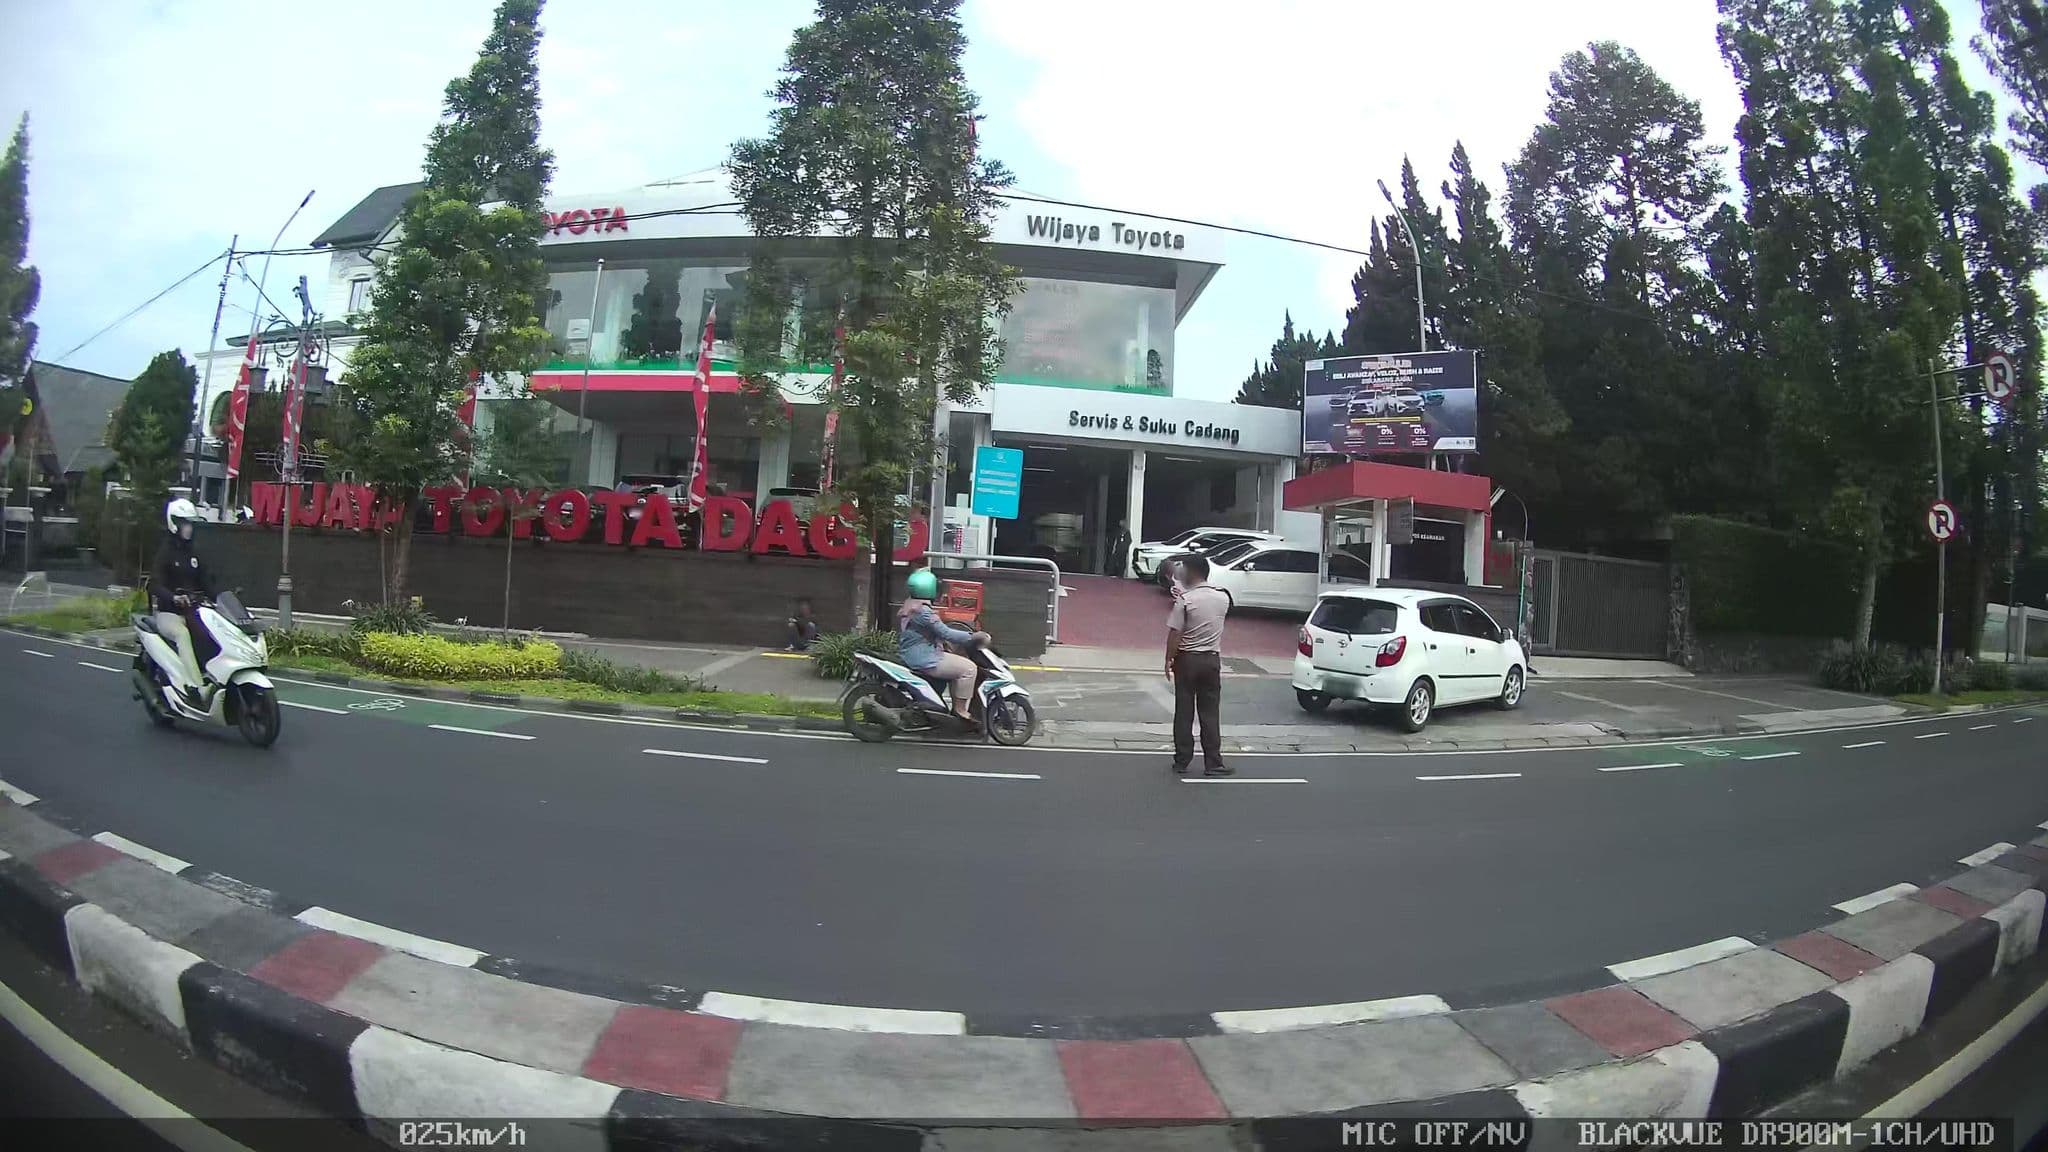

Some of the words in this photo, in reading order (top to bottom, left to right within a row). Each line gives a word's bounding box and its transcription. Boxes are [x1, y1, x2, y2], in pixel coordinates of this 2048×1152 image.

[1027, 215, 1100, 244] Wijaya
[1111, 222, 1185, 250] Toyota
[1069, 410, 1118, 431] Servis
[1122, 415, 1133, 430] &
[1139, 416, 1177, 435] Suku
[1184, 420, 1240, 444] Cadang
[424, 484, 684, 549] TOYOTA
